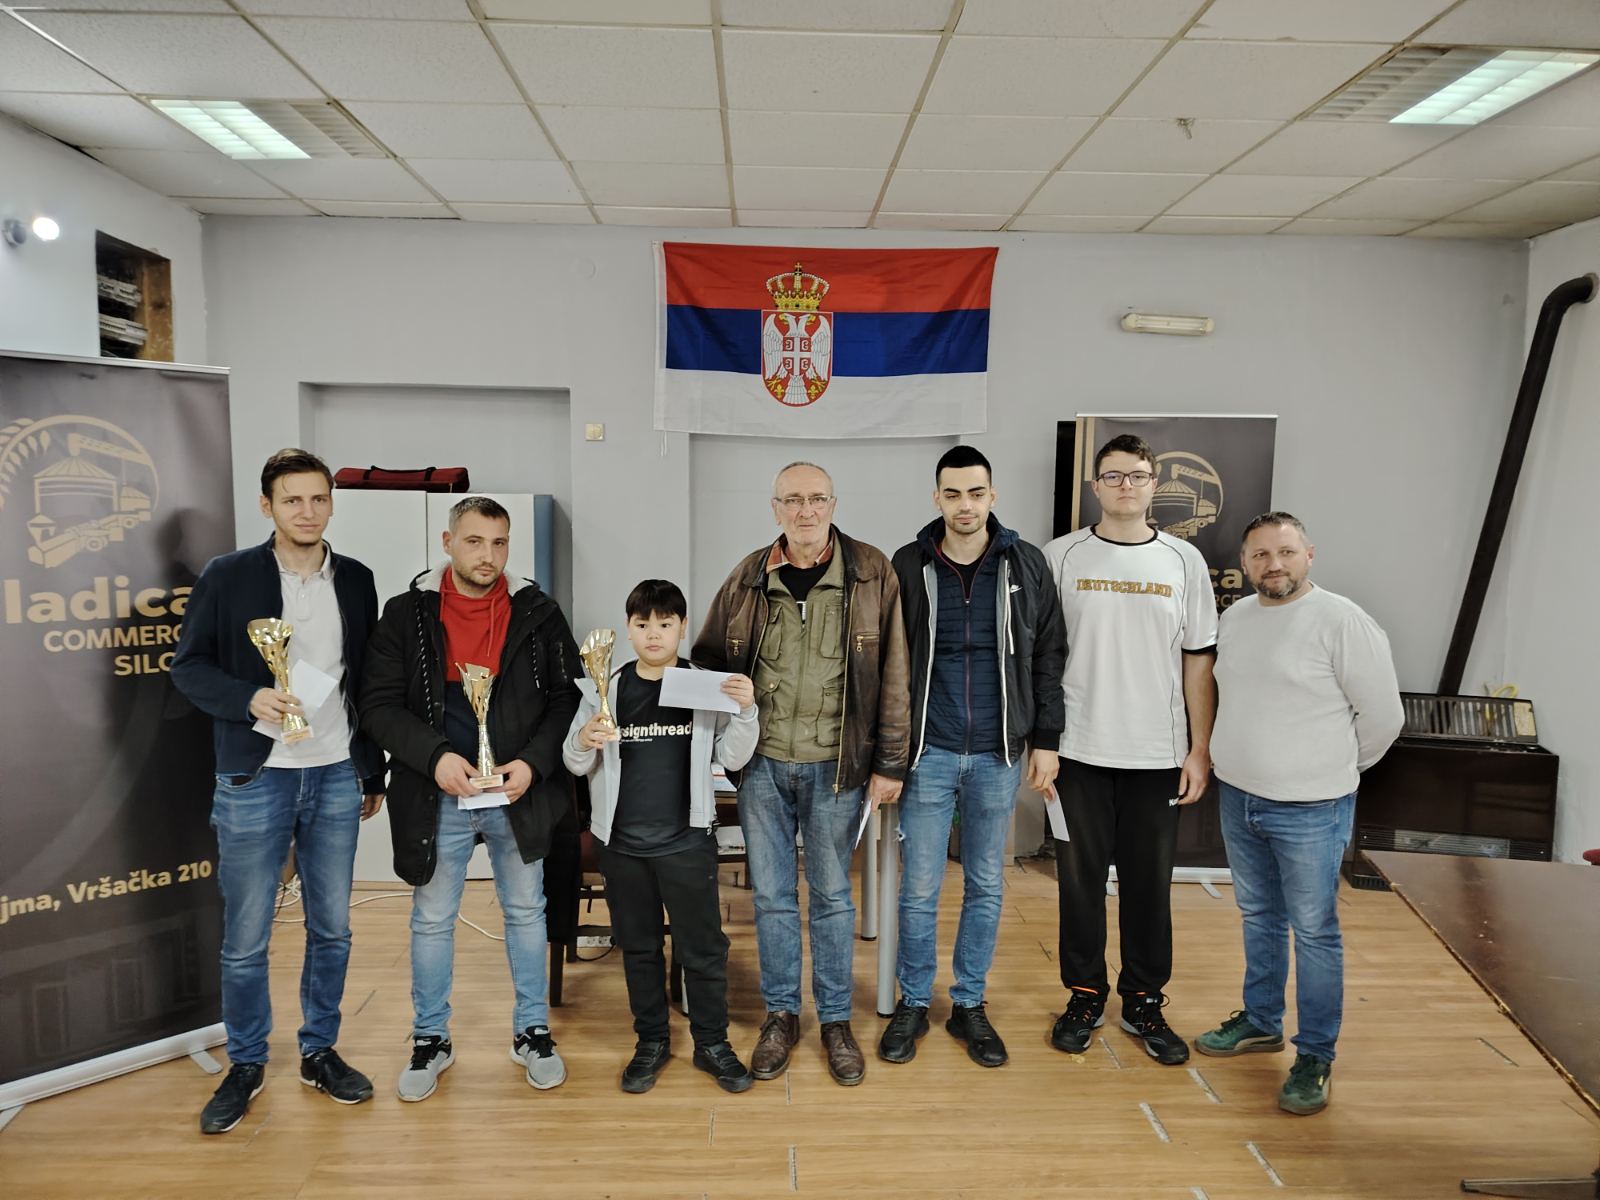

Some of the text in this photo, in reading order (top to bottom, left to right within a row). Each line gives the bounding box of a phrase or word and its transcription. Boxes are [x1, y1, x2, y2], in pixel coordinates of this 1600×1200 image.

[1076, 578, 1173, 598] DEUTSCHLAND
[66, 869, 172, 904] Vršačka
[177, 860, 213, 883] 210
